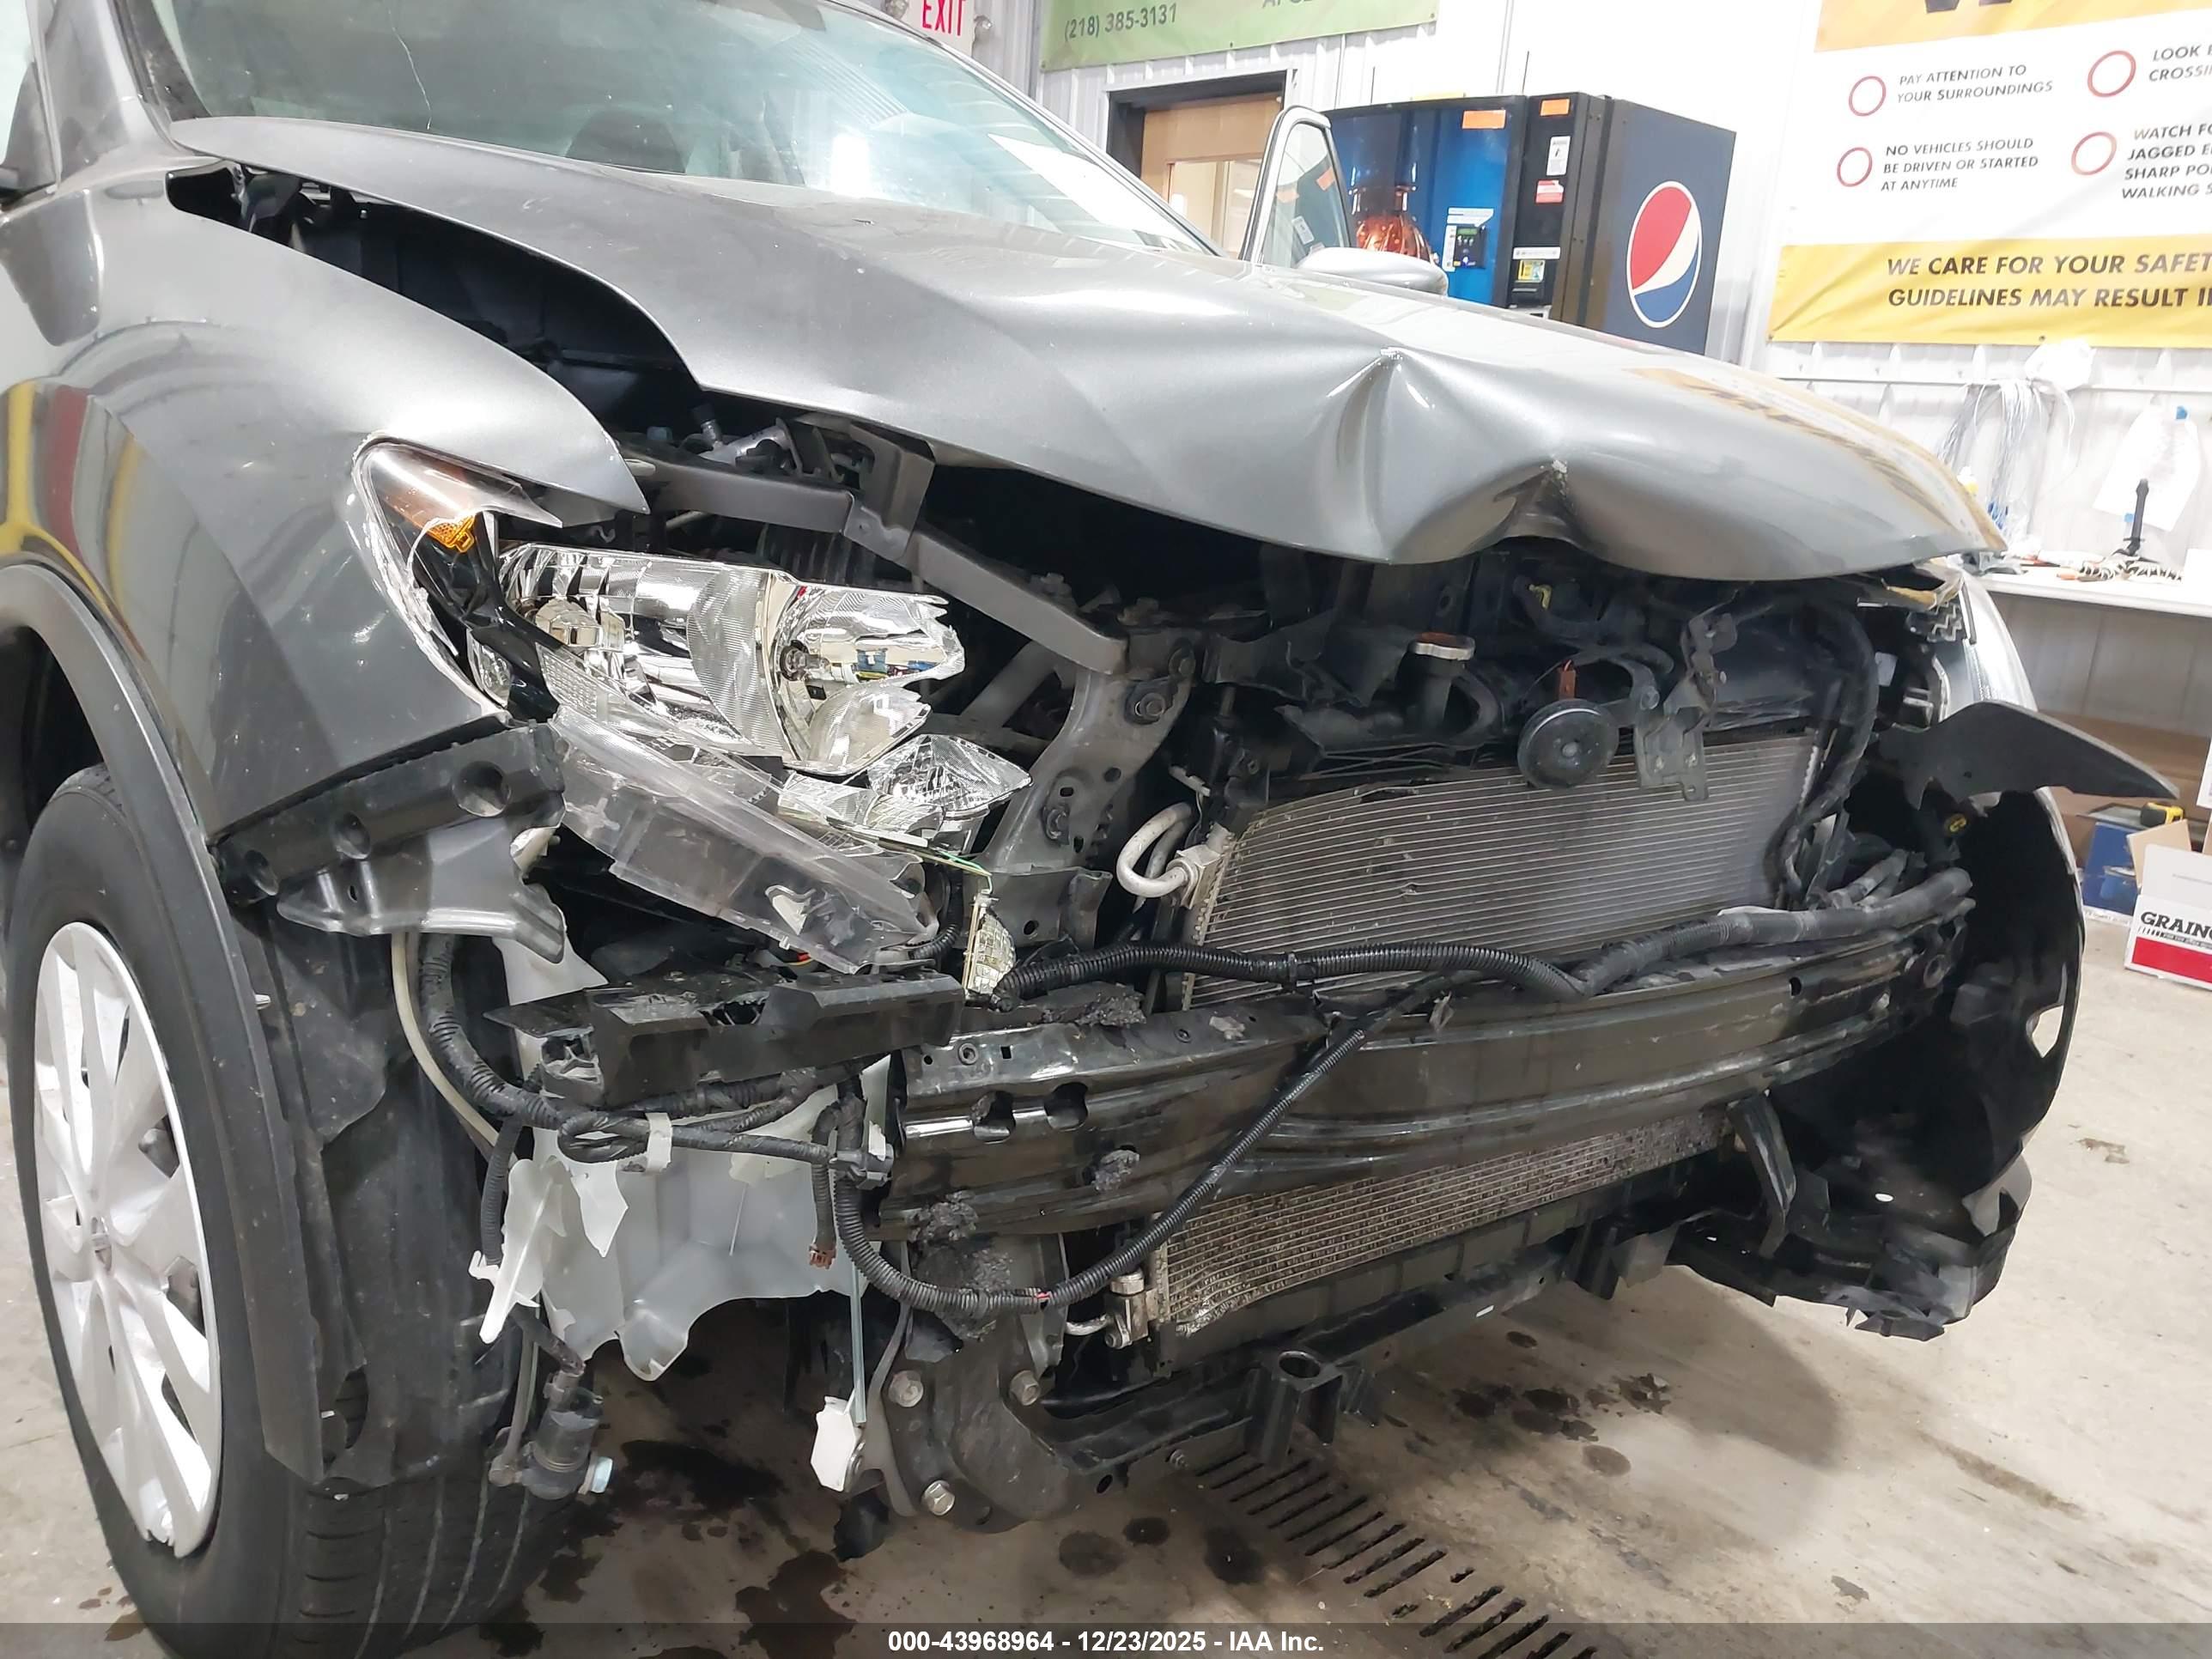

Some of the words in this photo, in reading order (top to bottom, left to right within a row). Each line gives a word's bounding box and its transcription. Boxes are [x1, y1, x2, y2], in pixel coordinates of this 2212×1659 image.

[921, 0, 966, 36] EXIT
[1064, 15, 1101, 42] (218)
[1104, 3, 1177, 33] 385-3131
[2153, 45, 2202, 62] LOOK
[1899, 74, 1922, 85] PAY
[1926, 66, 2003, 82] ATTENTION
[2008, 64, 2027, 76] TO
[1897, 90, 1932, 103] YOUR
[1937, 81, 2053, 100] SURROUNDINGS
[2134, 125, 2192, 140] WATCH
[1886, 144, 1909, 156] NO
[1914, 141, 1972, 155] VEHICLES
[1977, 137, 2034, 151] SHOULD
[2127, 144, 2196, 161] JAGGED
[2202, 143, 2212, 155] E
[1883, 162, 1899, 174] BE
[1903, 161, 1952, 173] DRIVEN
[1956, 159, 1975, 171] OR
[1979, 156, 2039, 169] STARTED
[2124, 166, 2180, 180] SHARP
[2185, 163, 2212, 177] PO
[1881, 180, 1897, 191] AT
[1900, 177, 1959, 191] ANYTIME
[2122, 184, 2199, 199] WALKING
[1887, 258, 1920, 275] WE
[1928, 257, 1989, 275] CARE
[1996, 256, 2043, 274] FOR
[2055, 255, 2125, 274] YOUR
[2134, 252, 2212, 273] SAFET
[1888, 289, 2022, 307] GUIDELINES
[2029, 288, 2087, 307] MAY
[2094, 288, 2189, 307] RESULT
